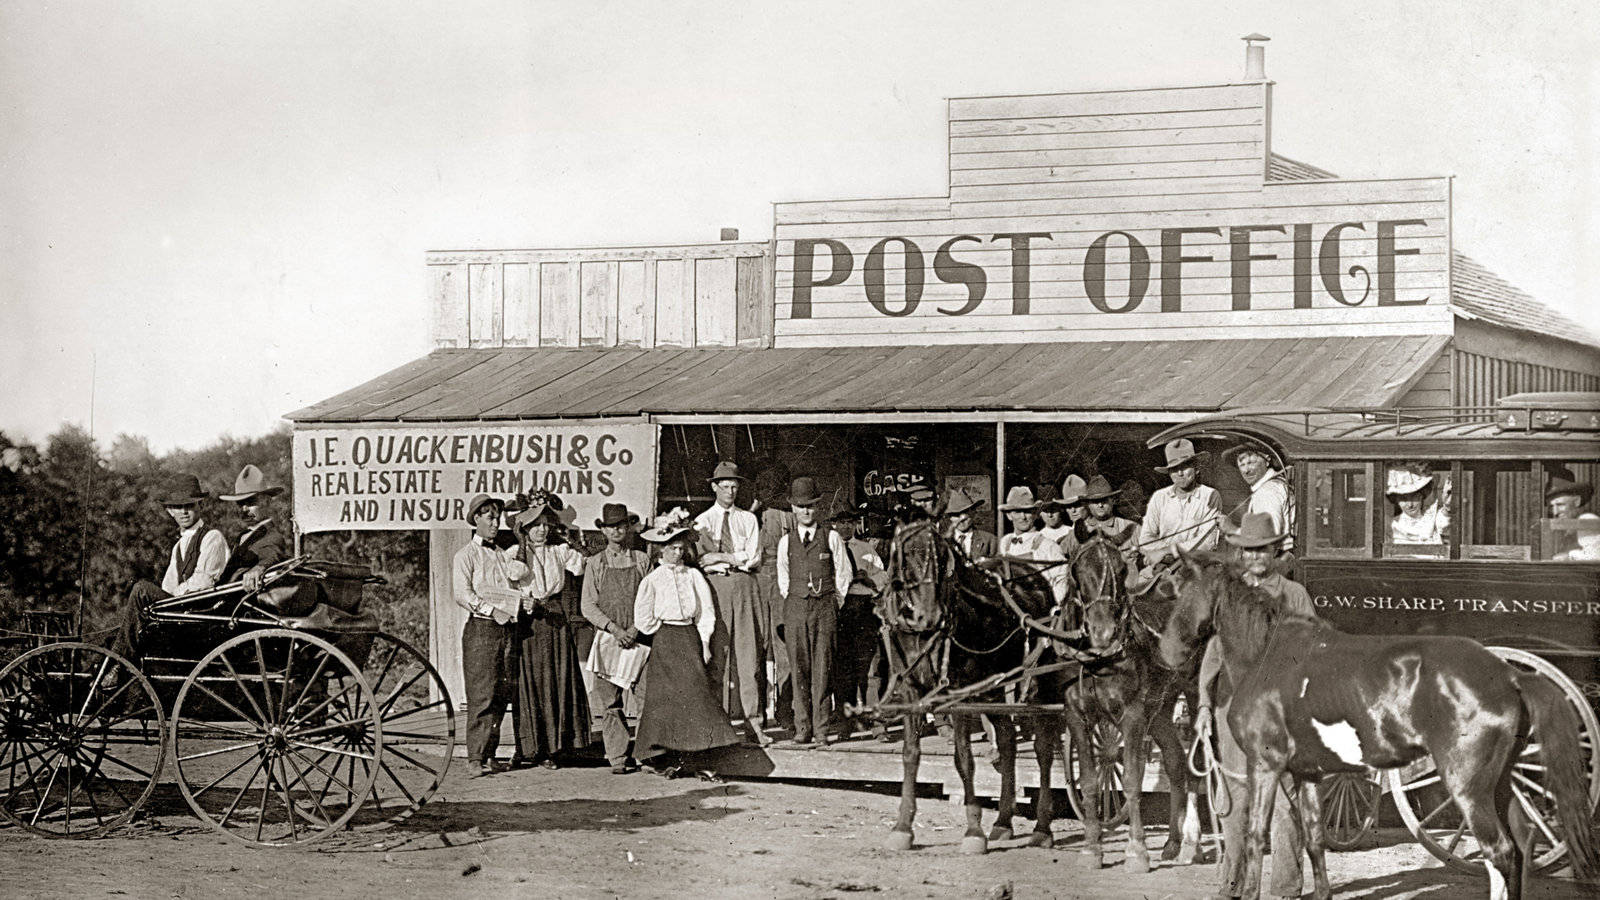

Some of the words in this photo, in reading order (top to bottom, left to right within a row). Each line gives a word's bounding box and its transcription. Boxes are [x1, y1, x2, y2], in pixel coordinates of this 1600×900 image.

[790, 232, 1053, 320] POST
[1083, 218, 1429, 313] OFFICE
[304, 437, 347, 468] J.E.
[340, 500, 379, 522] AND
[389, 499, 464, 522] INSUR
[1454, 598, 1600, 615] TRANSFER
